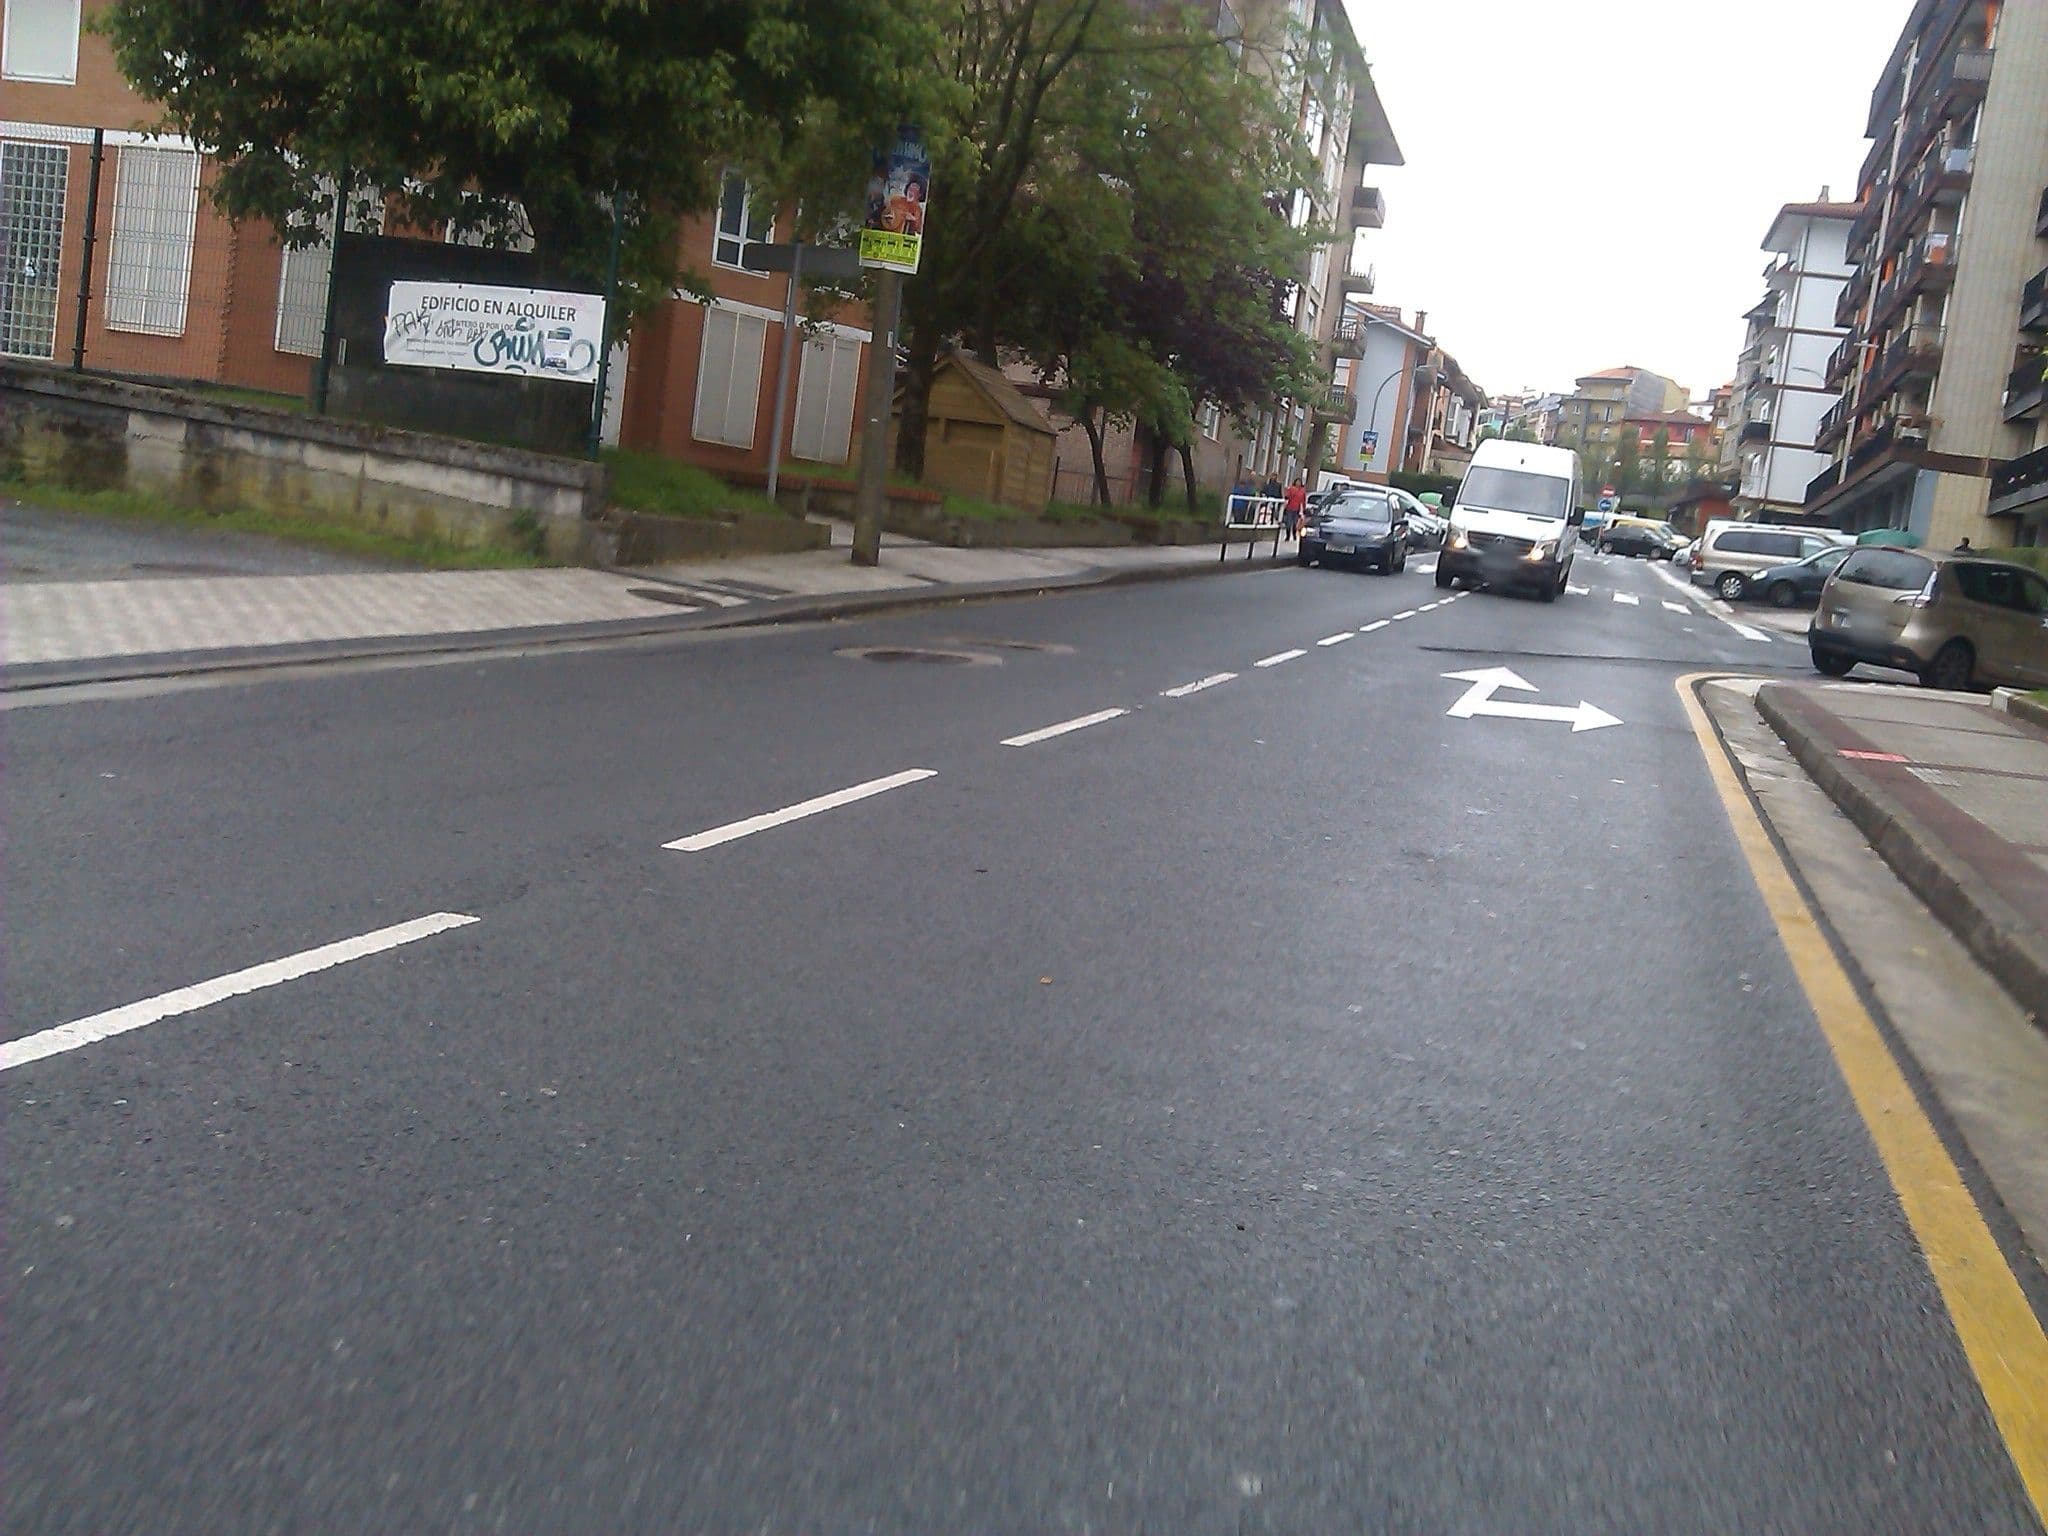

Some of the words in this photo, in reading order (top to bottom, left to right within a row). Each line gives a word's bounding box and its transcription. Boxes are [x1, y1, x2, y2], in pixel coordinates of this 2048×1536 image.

[421, 296, 480, 313] EDIFICIO
[483, 300, 503, 315] EN
[506, 302, 576, 322] ALQUILER
